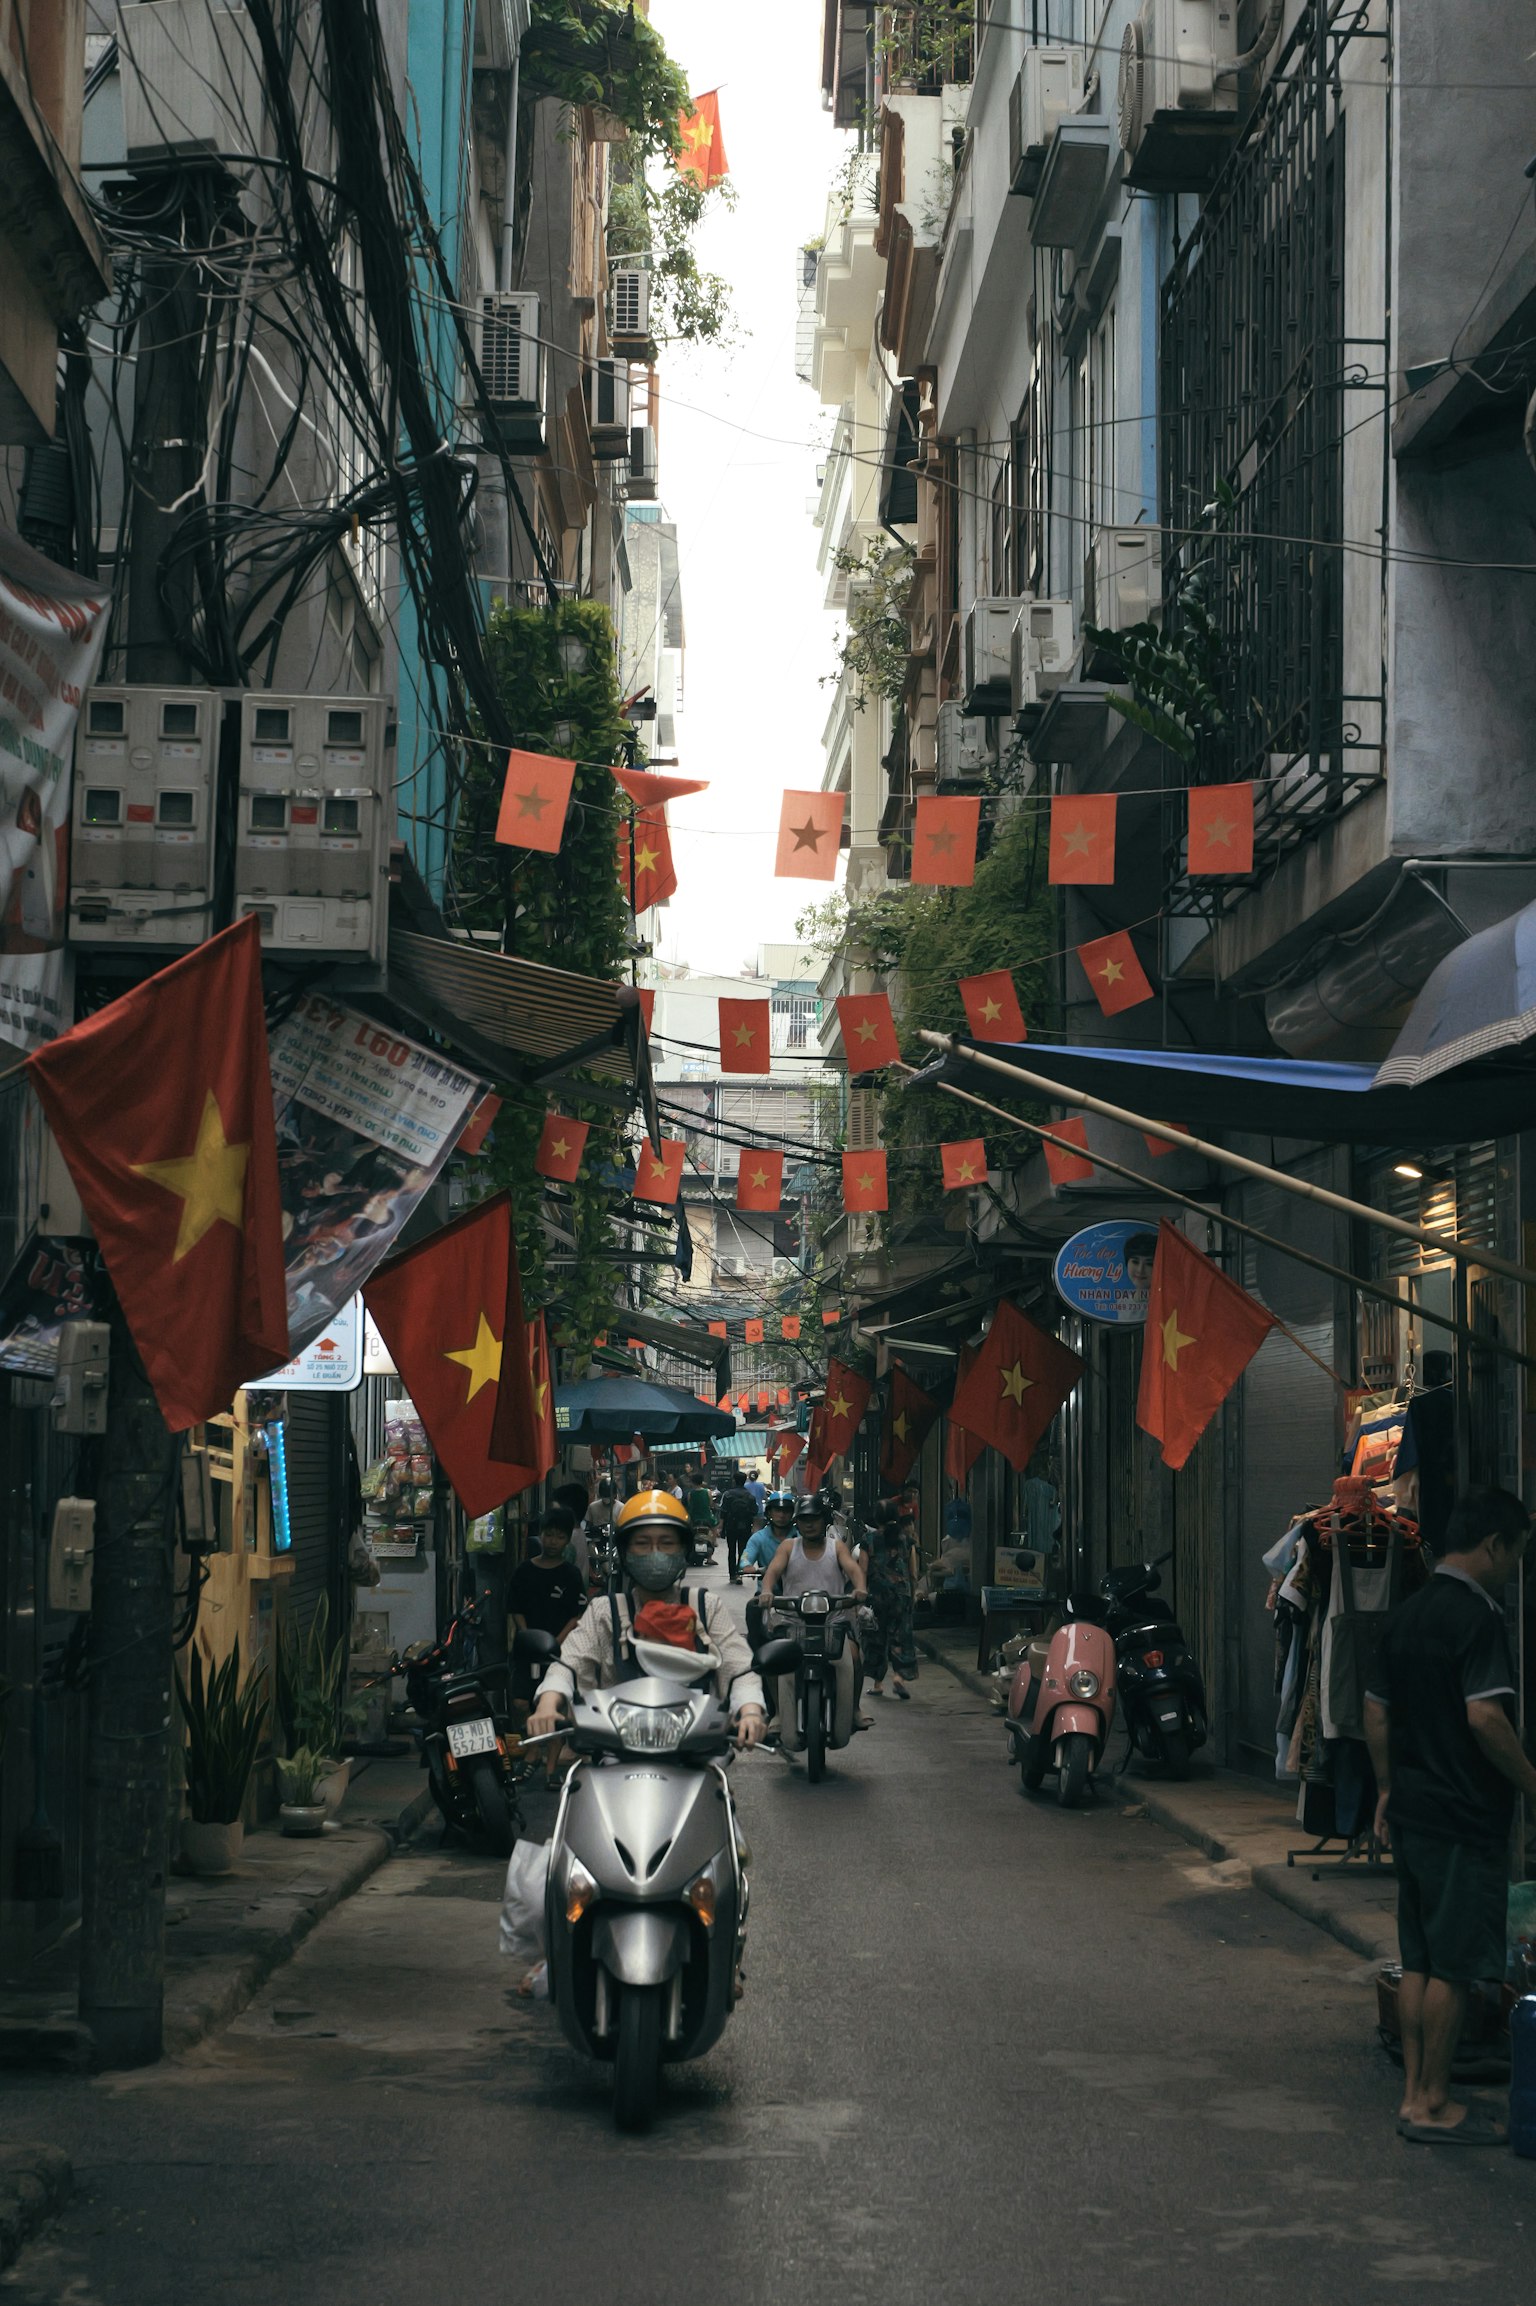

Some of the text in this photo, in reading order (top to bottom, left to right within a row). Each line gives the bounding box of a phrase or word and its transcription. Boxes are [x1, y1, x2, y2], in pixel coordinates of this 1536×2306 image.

[351, 1020, 412, 1069] 091
[1063, 1262, 1104, 1282] Hương
[337, 1362, 349, 1371] 222
